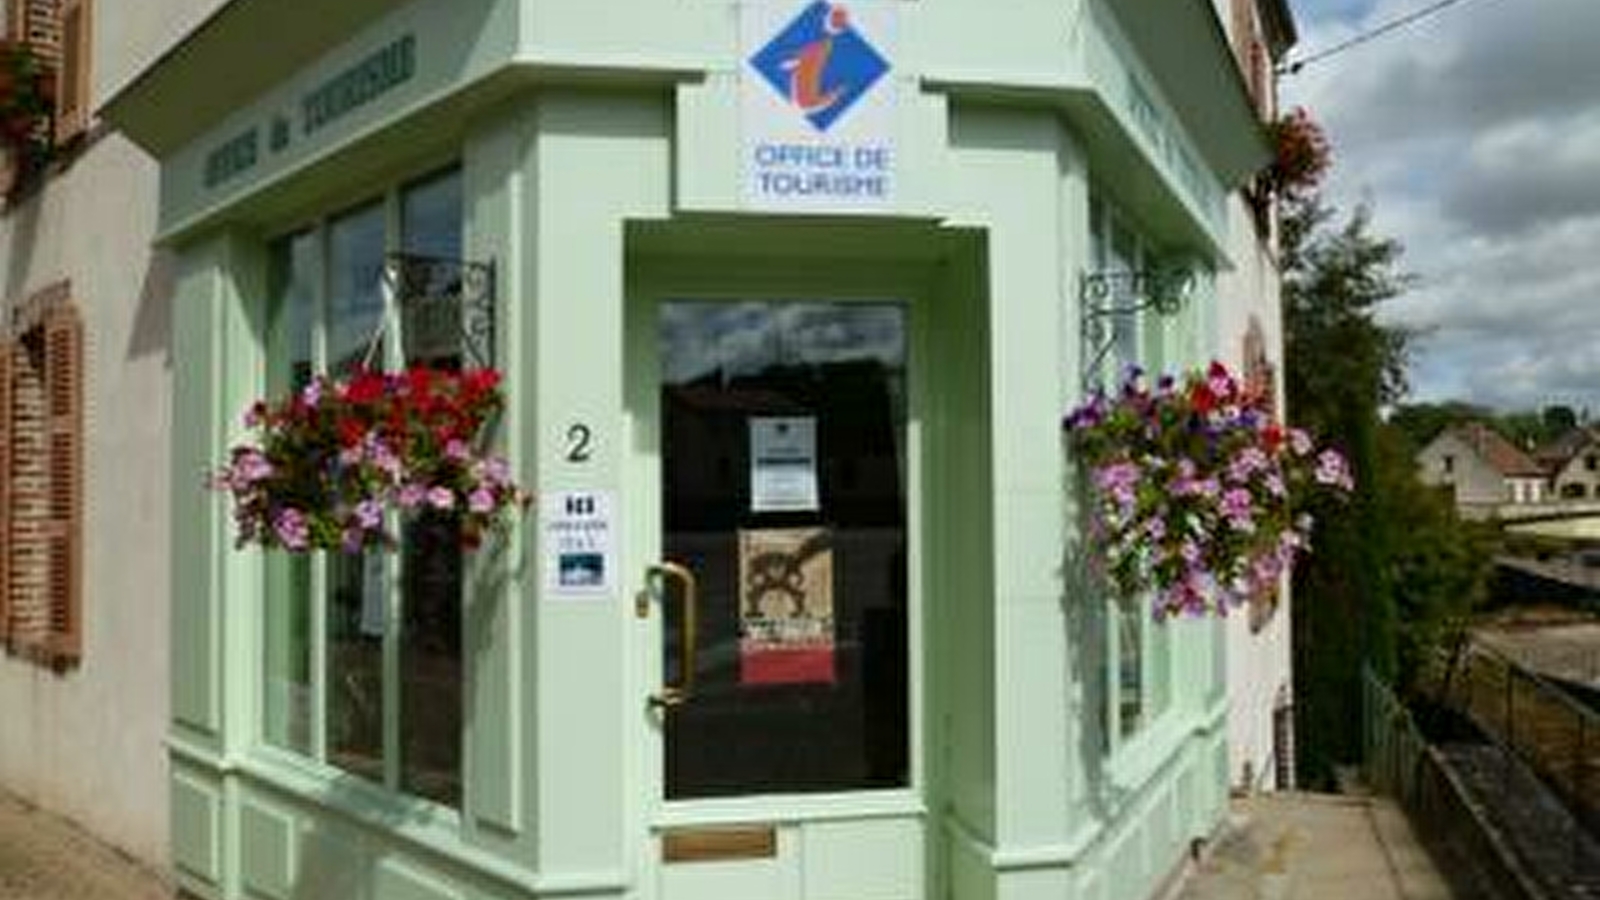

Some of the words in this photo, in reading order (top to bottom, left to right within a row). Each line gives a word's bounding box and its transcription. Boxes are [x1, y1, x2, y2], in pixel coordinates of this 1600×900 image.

[755, 145, 846, 168] OFFICE
[854, 147, 890, 170] DE
[757, 173, 889, 197] TOURISME
[566, 422, 592, 463] 2
